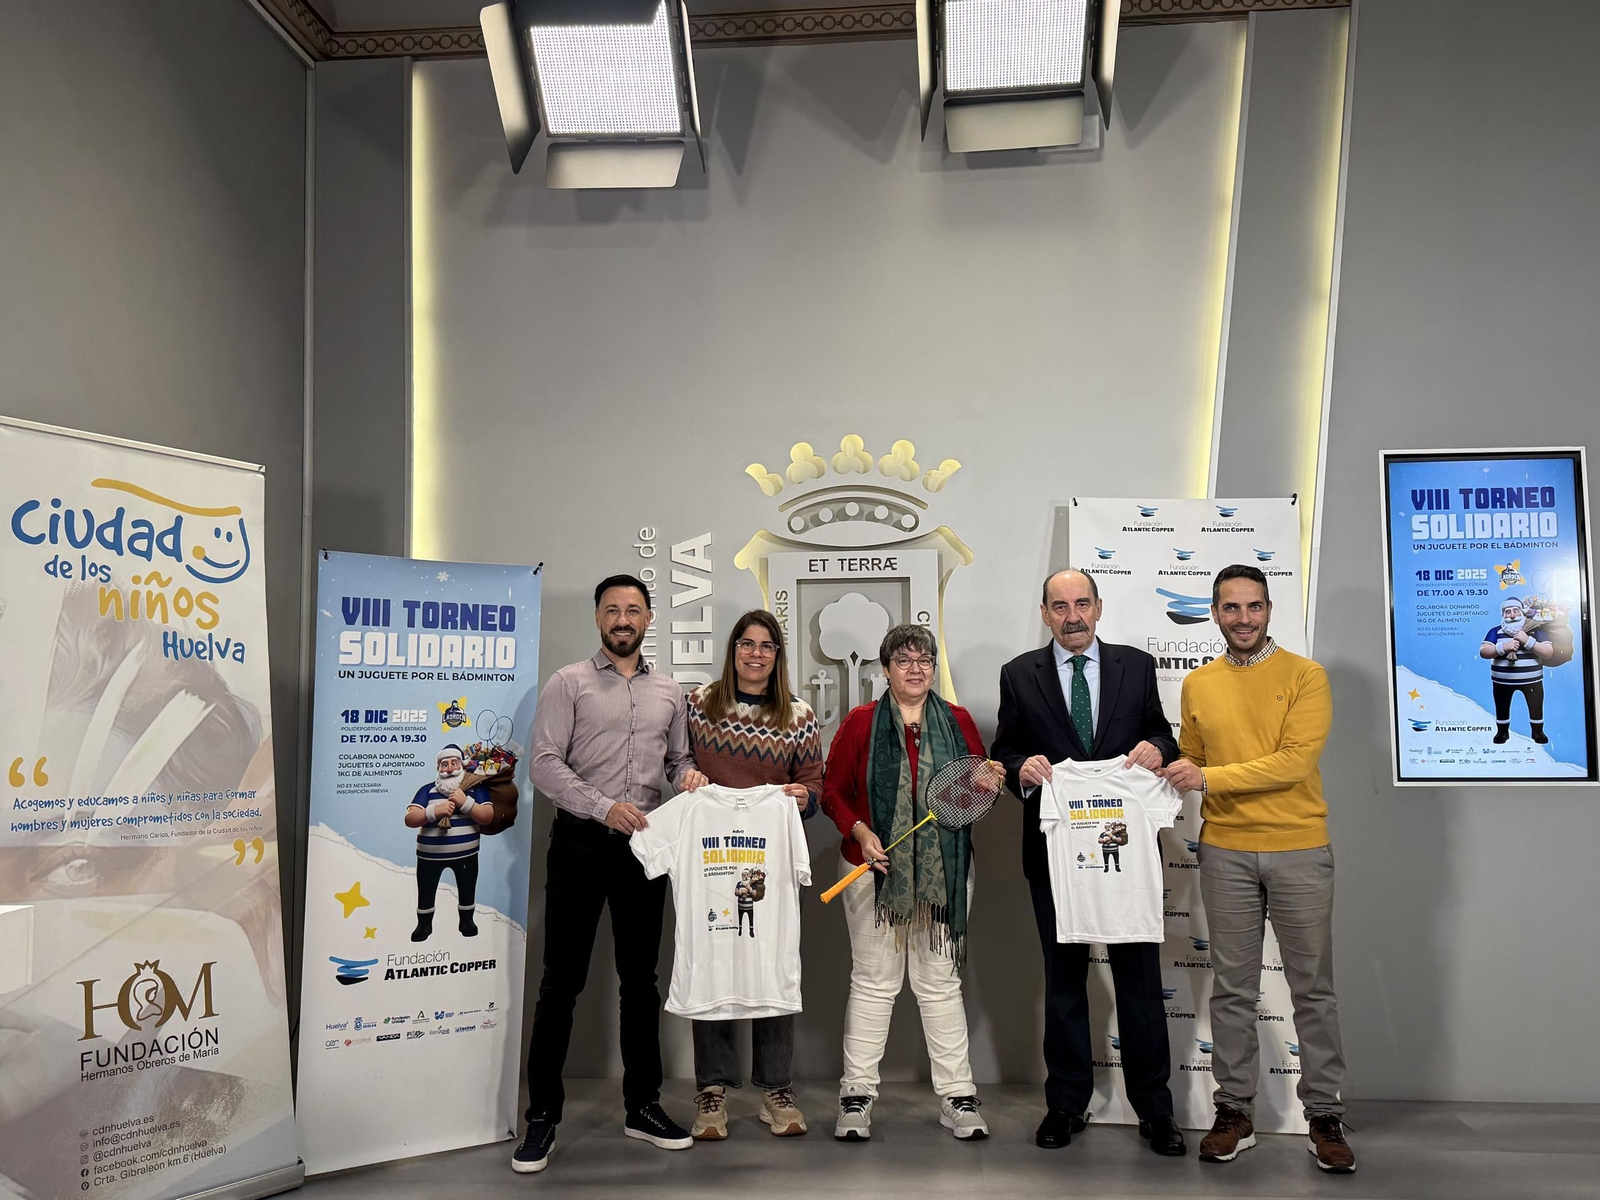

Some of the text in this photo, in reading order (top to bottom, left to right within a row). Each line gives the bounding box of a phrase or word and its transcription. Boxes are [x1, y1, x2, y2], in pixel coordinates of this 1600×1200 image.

[1411, 486, 1555, 510] VIII TORNEO
[11, 498, 184, 562] Ciudad
[1411, 512, 1557, 540] SOLIDARIO
[633, 526, 657, 558] de
[1504, 540, 1558, 549] BÁDMINTON
[44, 555, 112, 583] de los
[808, 558, 830, 572] ET
[1415, 568, 1487, 580] 18 DIC 2025
[99, 571, 220, 630] niños
[341, 596, 516, 632] VIII TORNEO
[162, 631, 246, 664] Huelva
[338, 630, 516, 669] SOLIDARIO
[1147, 637, 1228, 654] Fundació
[338, 670, 515, 682] UN JUGUETE POR EL BÁDMINTON
[340, 710, 360, 724] 18
[364, 710, 388, 724] DIC
[392, 709, 428, 723] 2025
[1435, 718, 1468, 726] Fundación
[360, 734, 387, 742] 17.00
[400, 734, 426, 742] 19.30
[13, 789, 257, 812] Acogemos y educamos a niños y niñas para formar
[1068, 798, 1122, 809] VIII TORNEO
[10, 808, 262, 832] hombres y mujeres comprometidos con la sociedad.
[1070, 808, 1124, 820] SOLIDARIO
[702, 836, 766, 849] VIII TORNEO
[702, 849, 766, 864] SOLIDARIO
[386, 950, 450, 966] Fundación
[384, 960, 496, 981] ATLANTIC COPPER
[80, 1026, 219, 1072] FUNDACIÓN
[81, 1046, 220, 1082] Hermanos Obreros de María
[92, 1114, 154, 1136] cdnhuelva.es
[92, 1120, 180, 1148] info@cdnhuelva.es
[92, 1140, 152, 1163] @cdnhuelva
[94, 1138, 208, 1175] facebook.com/cdnhuelva
[94, 1144, 227, 1187] Crta. Gibraleón km.6 (Huelva)
